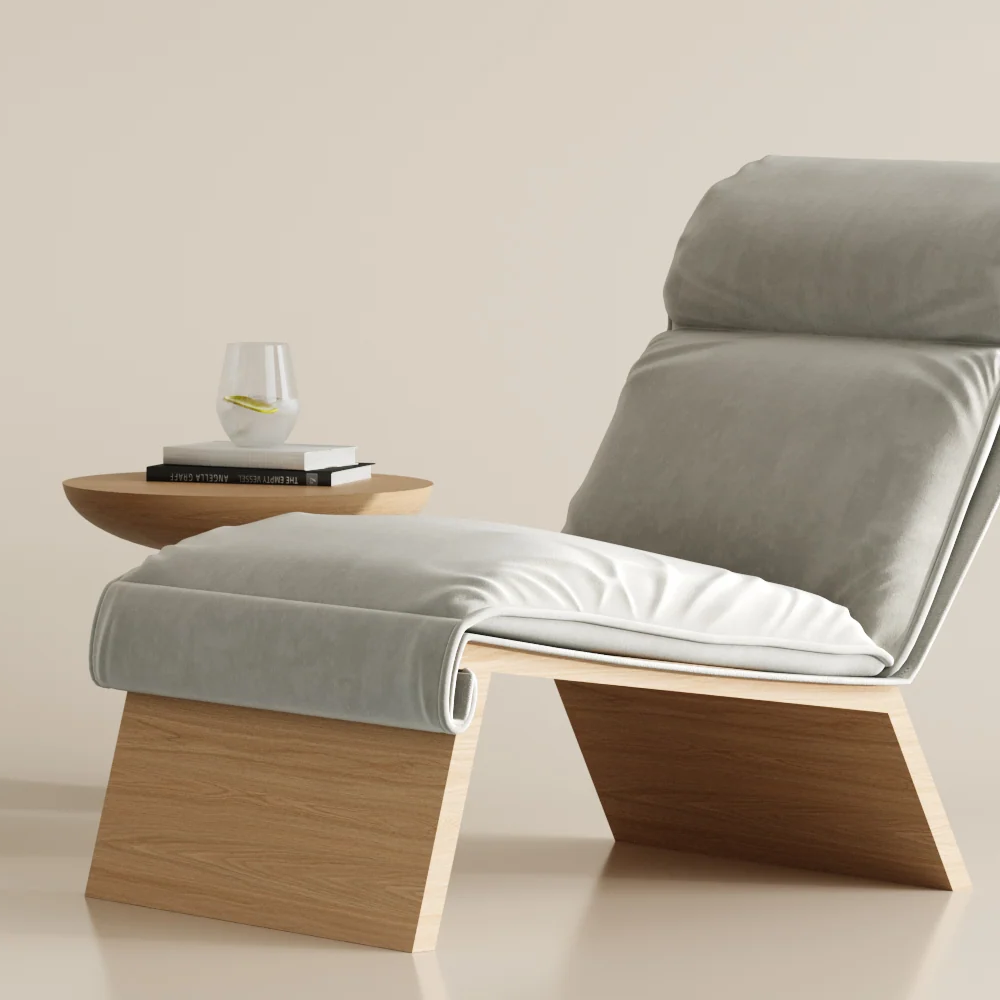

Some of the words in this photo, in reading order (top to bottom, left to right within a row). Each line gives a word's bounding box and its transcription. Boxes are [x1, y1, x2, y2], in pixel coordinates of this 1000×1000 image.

[170, 472, 193, 482] GRAFF
[196, 473, 228, 482] ANGELLA
[238, 474, 261, 483] VESSEL
[262, 475, 284, 484] EMPTY
[286, 476, 298, 484] THE
